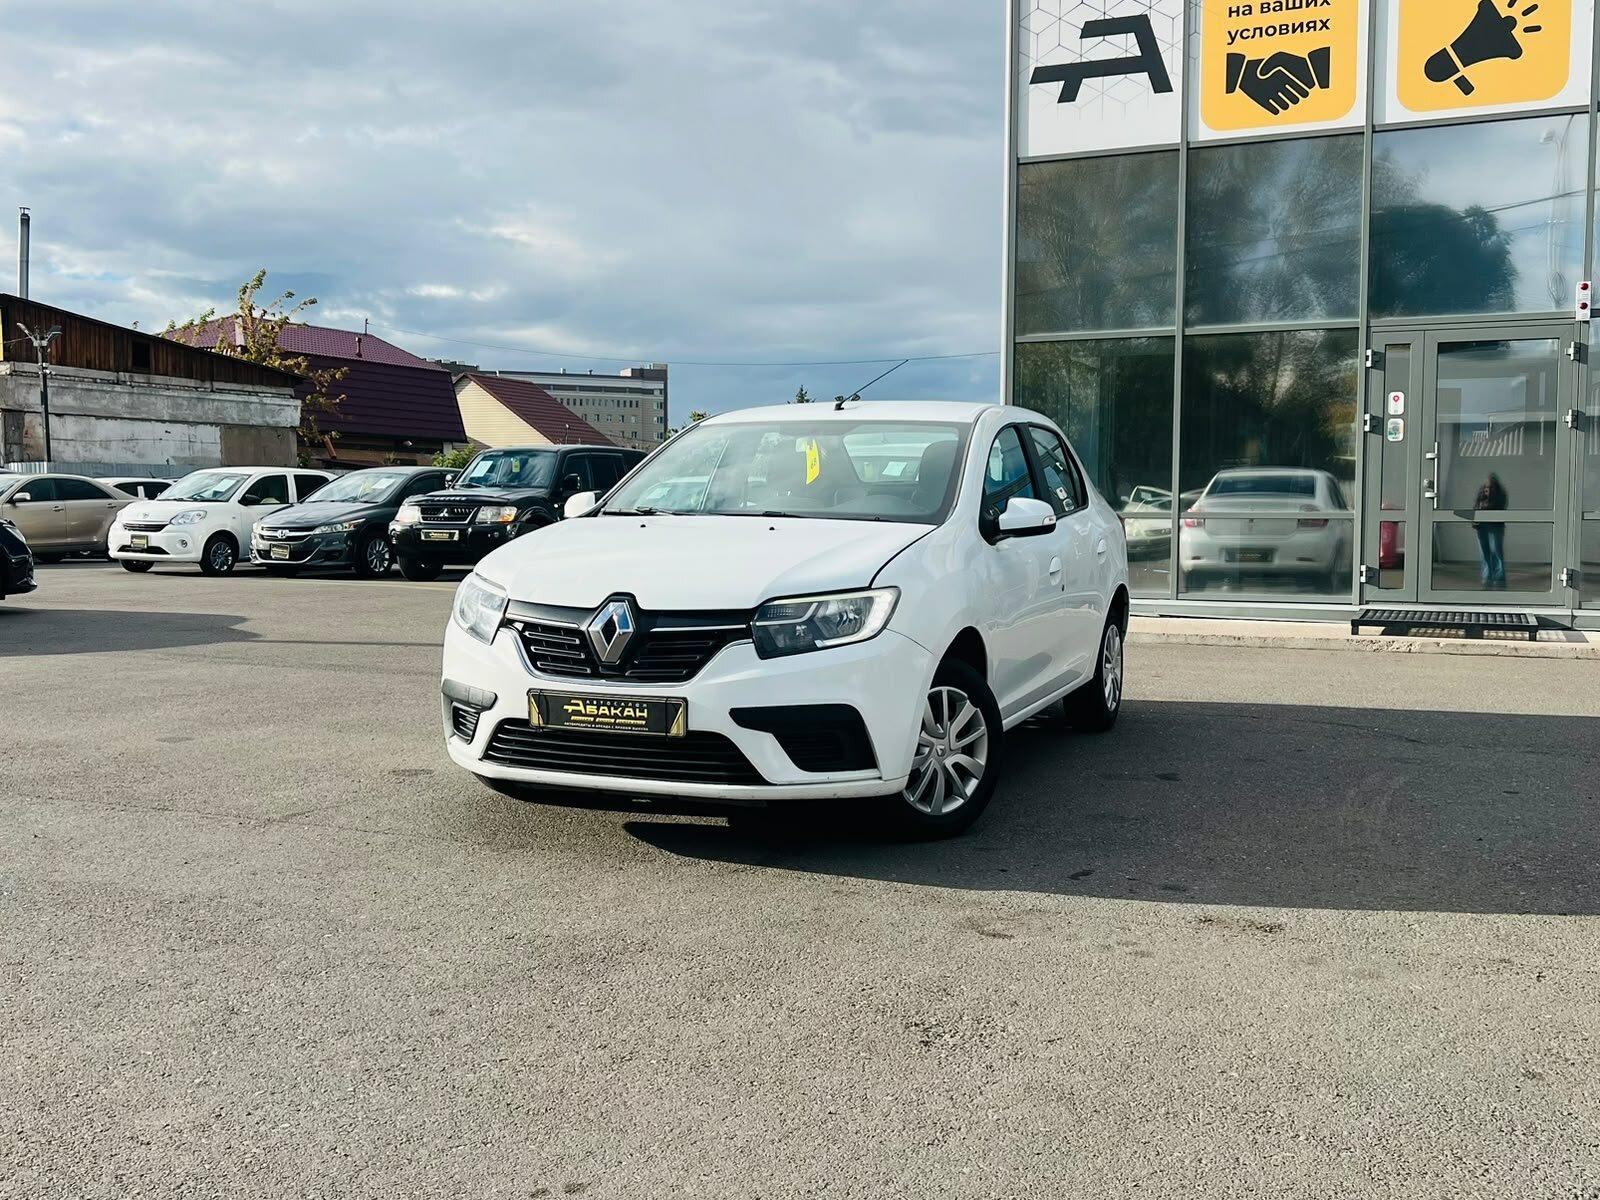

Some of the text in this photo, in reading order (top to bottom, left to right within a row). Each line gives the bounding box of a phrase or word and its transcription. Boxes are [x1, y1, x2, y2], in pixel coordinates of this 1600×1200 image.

[1228, 4, 1253, 18] на
[1227, 18, 1331, 45] условиях
[563, 700, 647, 718] АБАКАН
